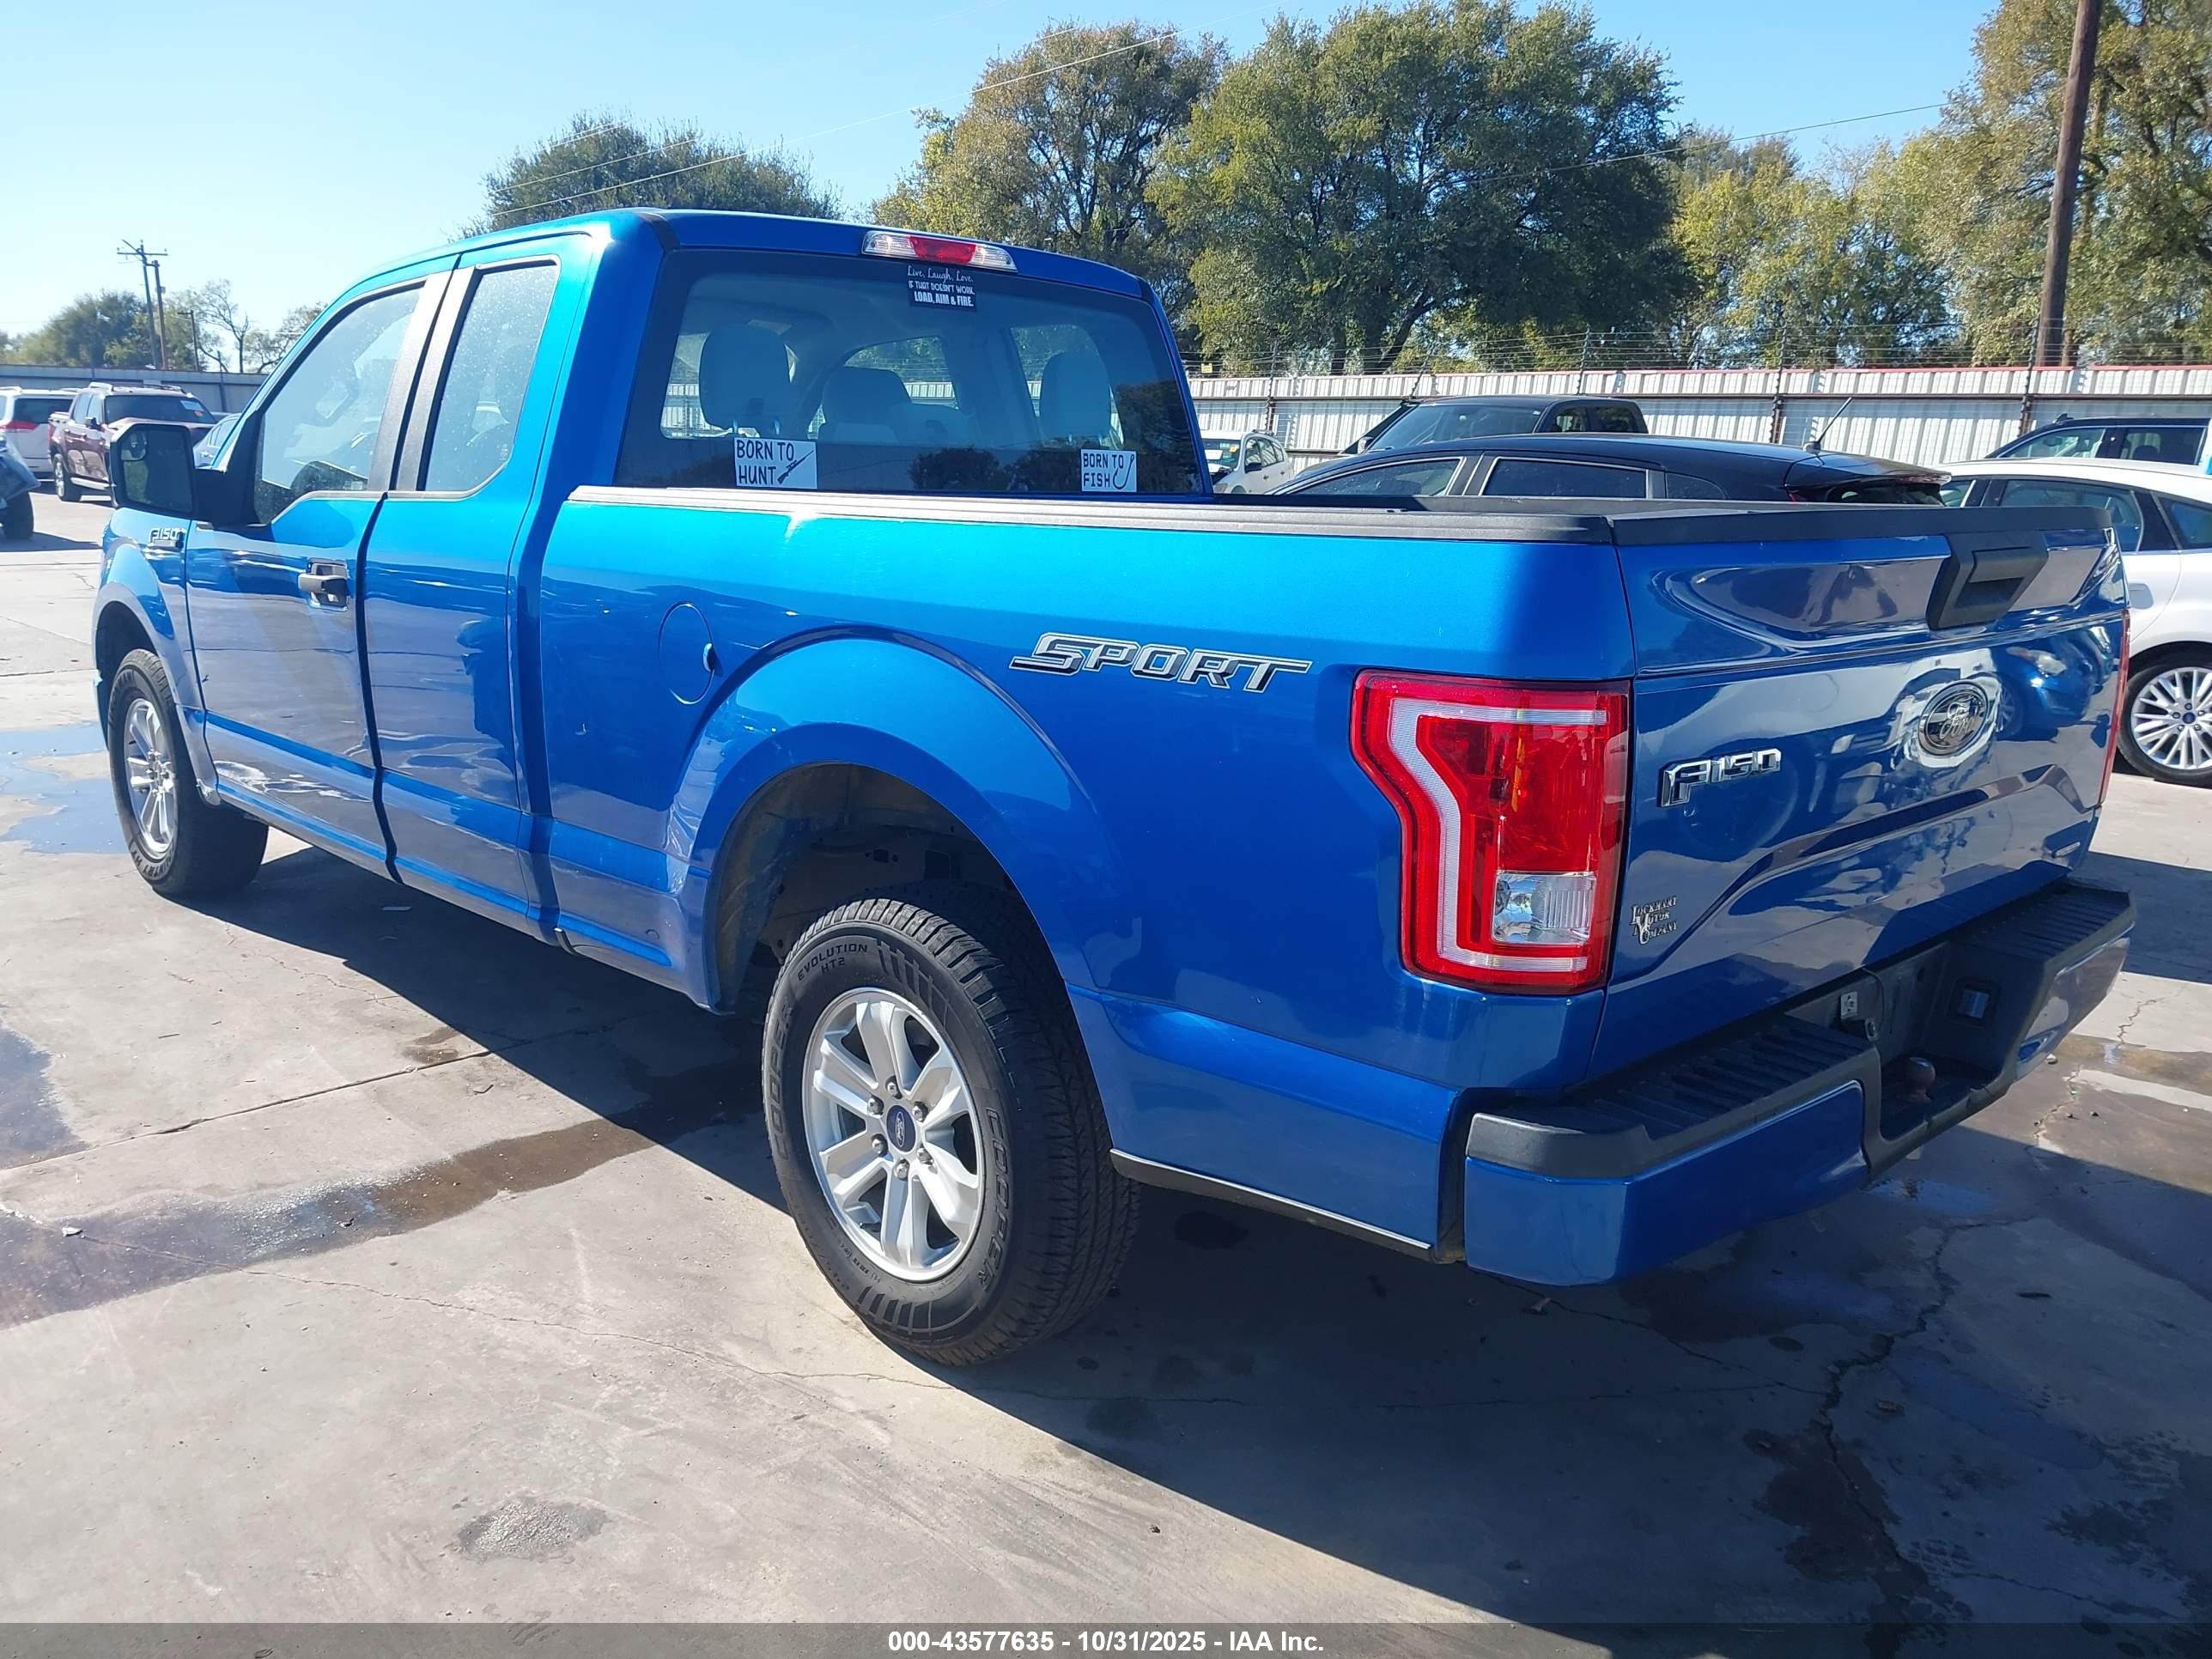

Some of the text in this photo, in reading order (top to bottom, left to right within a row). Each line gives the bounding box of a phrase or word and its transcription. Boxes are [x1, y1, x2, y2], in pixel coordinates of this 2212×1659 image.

[927, 268, 954, 283] Laugh,
[908, 281, 914, 289] IF
[915, 281, 930, 290] THAT
[935, 293, 950, 305] AIM
[951, 296, 957, 306] &
[957, 295, 974, 307] FIRE.
[737, 440, 794, 461] BORN TO
[1083, 453, 1124, 469] BORN TO
[738, 465, 777, 485] HUNT
[1084, 472, 1110, 488] FISH
[1009, 632, 1313, 693] SPORT
[797, 944, 868, 981] EVOLUTION
[821, 957, 846, 974] HT2
[978, 1107, 1010, 1291] COOPER
